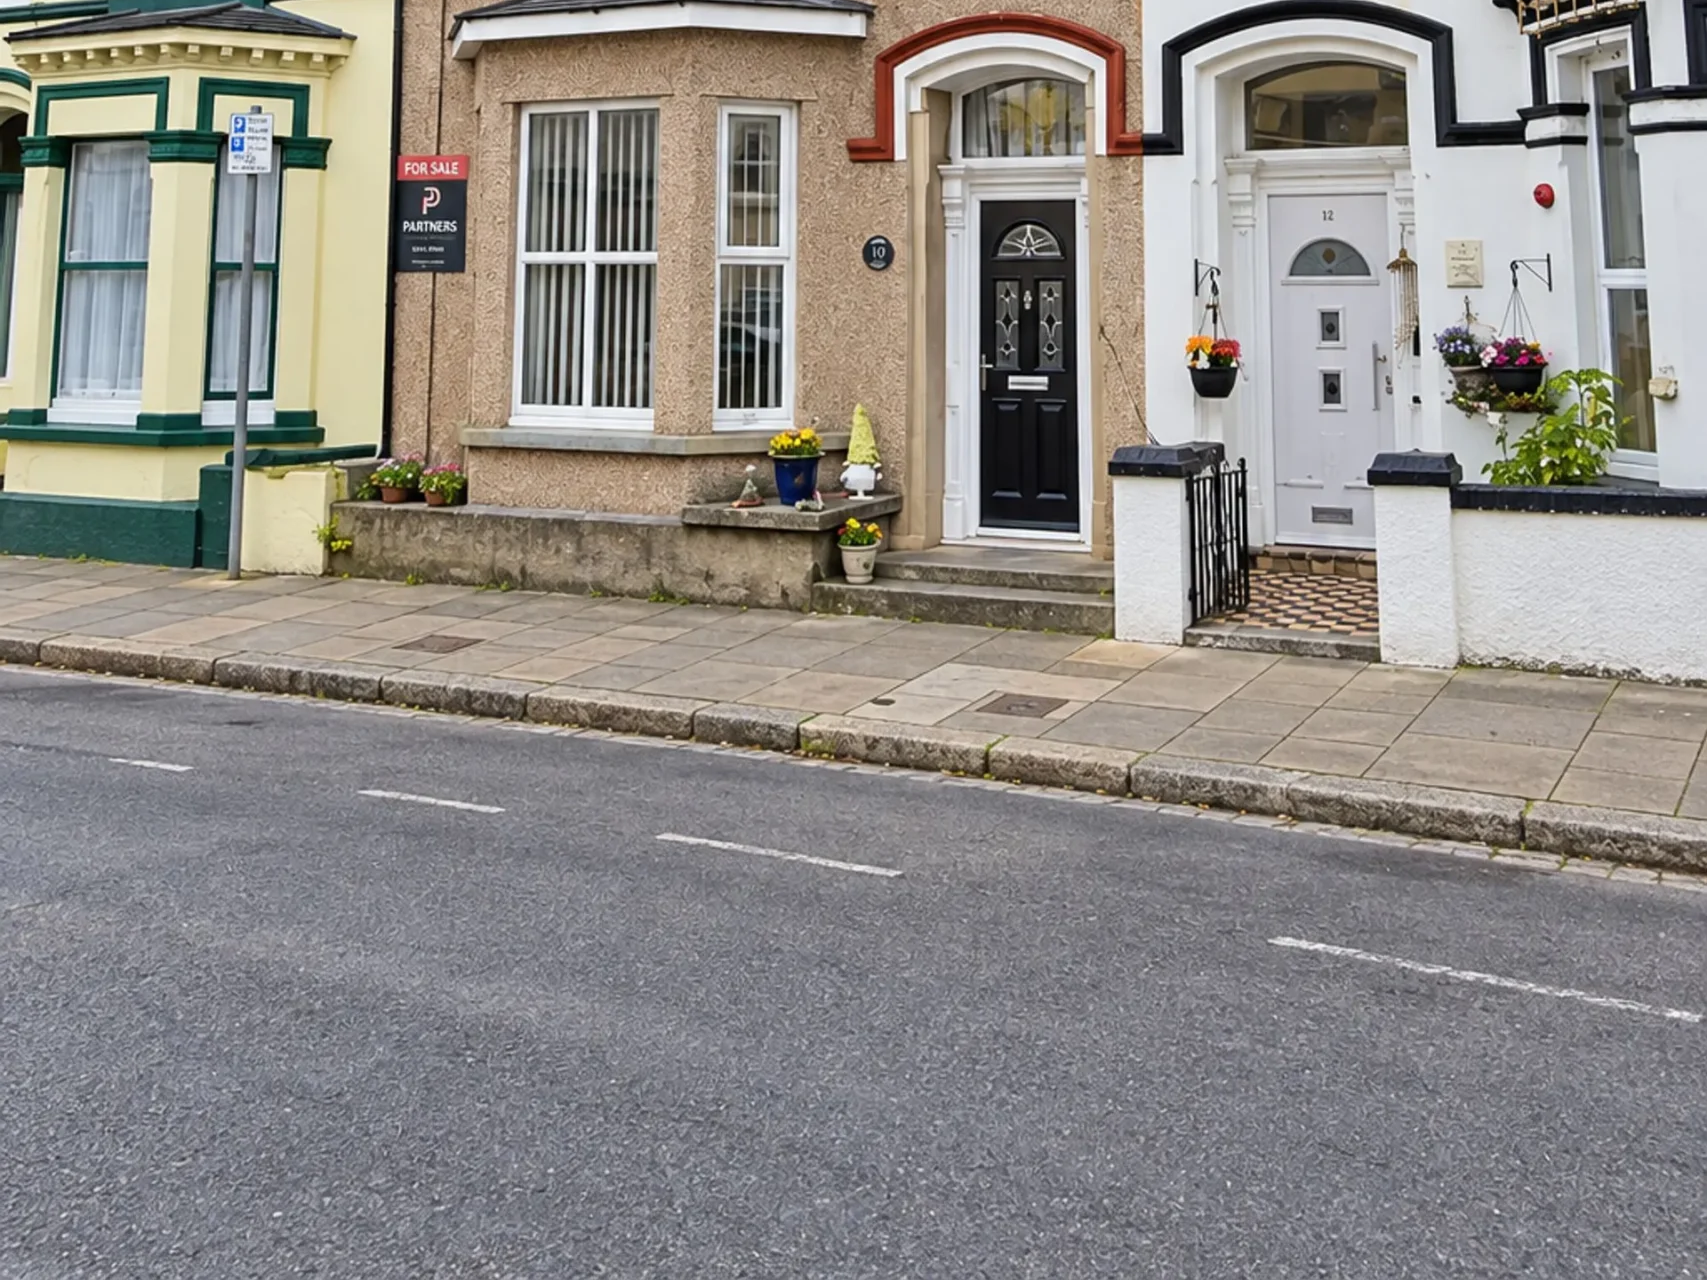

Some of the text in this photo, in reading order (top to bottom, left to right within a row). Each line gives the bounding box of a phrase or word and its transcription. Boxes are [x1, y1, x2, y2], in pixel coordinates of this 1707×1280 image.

[404, 160, 459, 176] FOR SALE
[1322, 209, 1335, 221] 12
[402, 220, 458, 233] PARTNERS
[872, 246, 887, 259] 10
